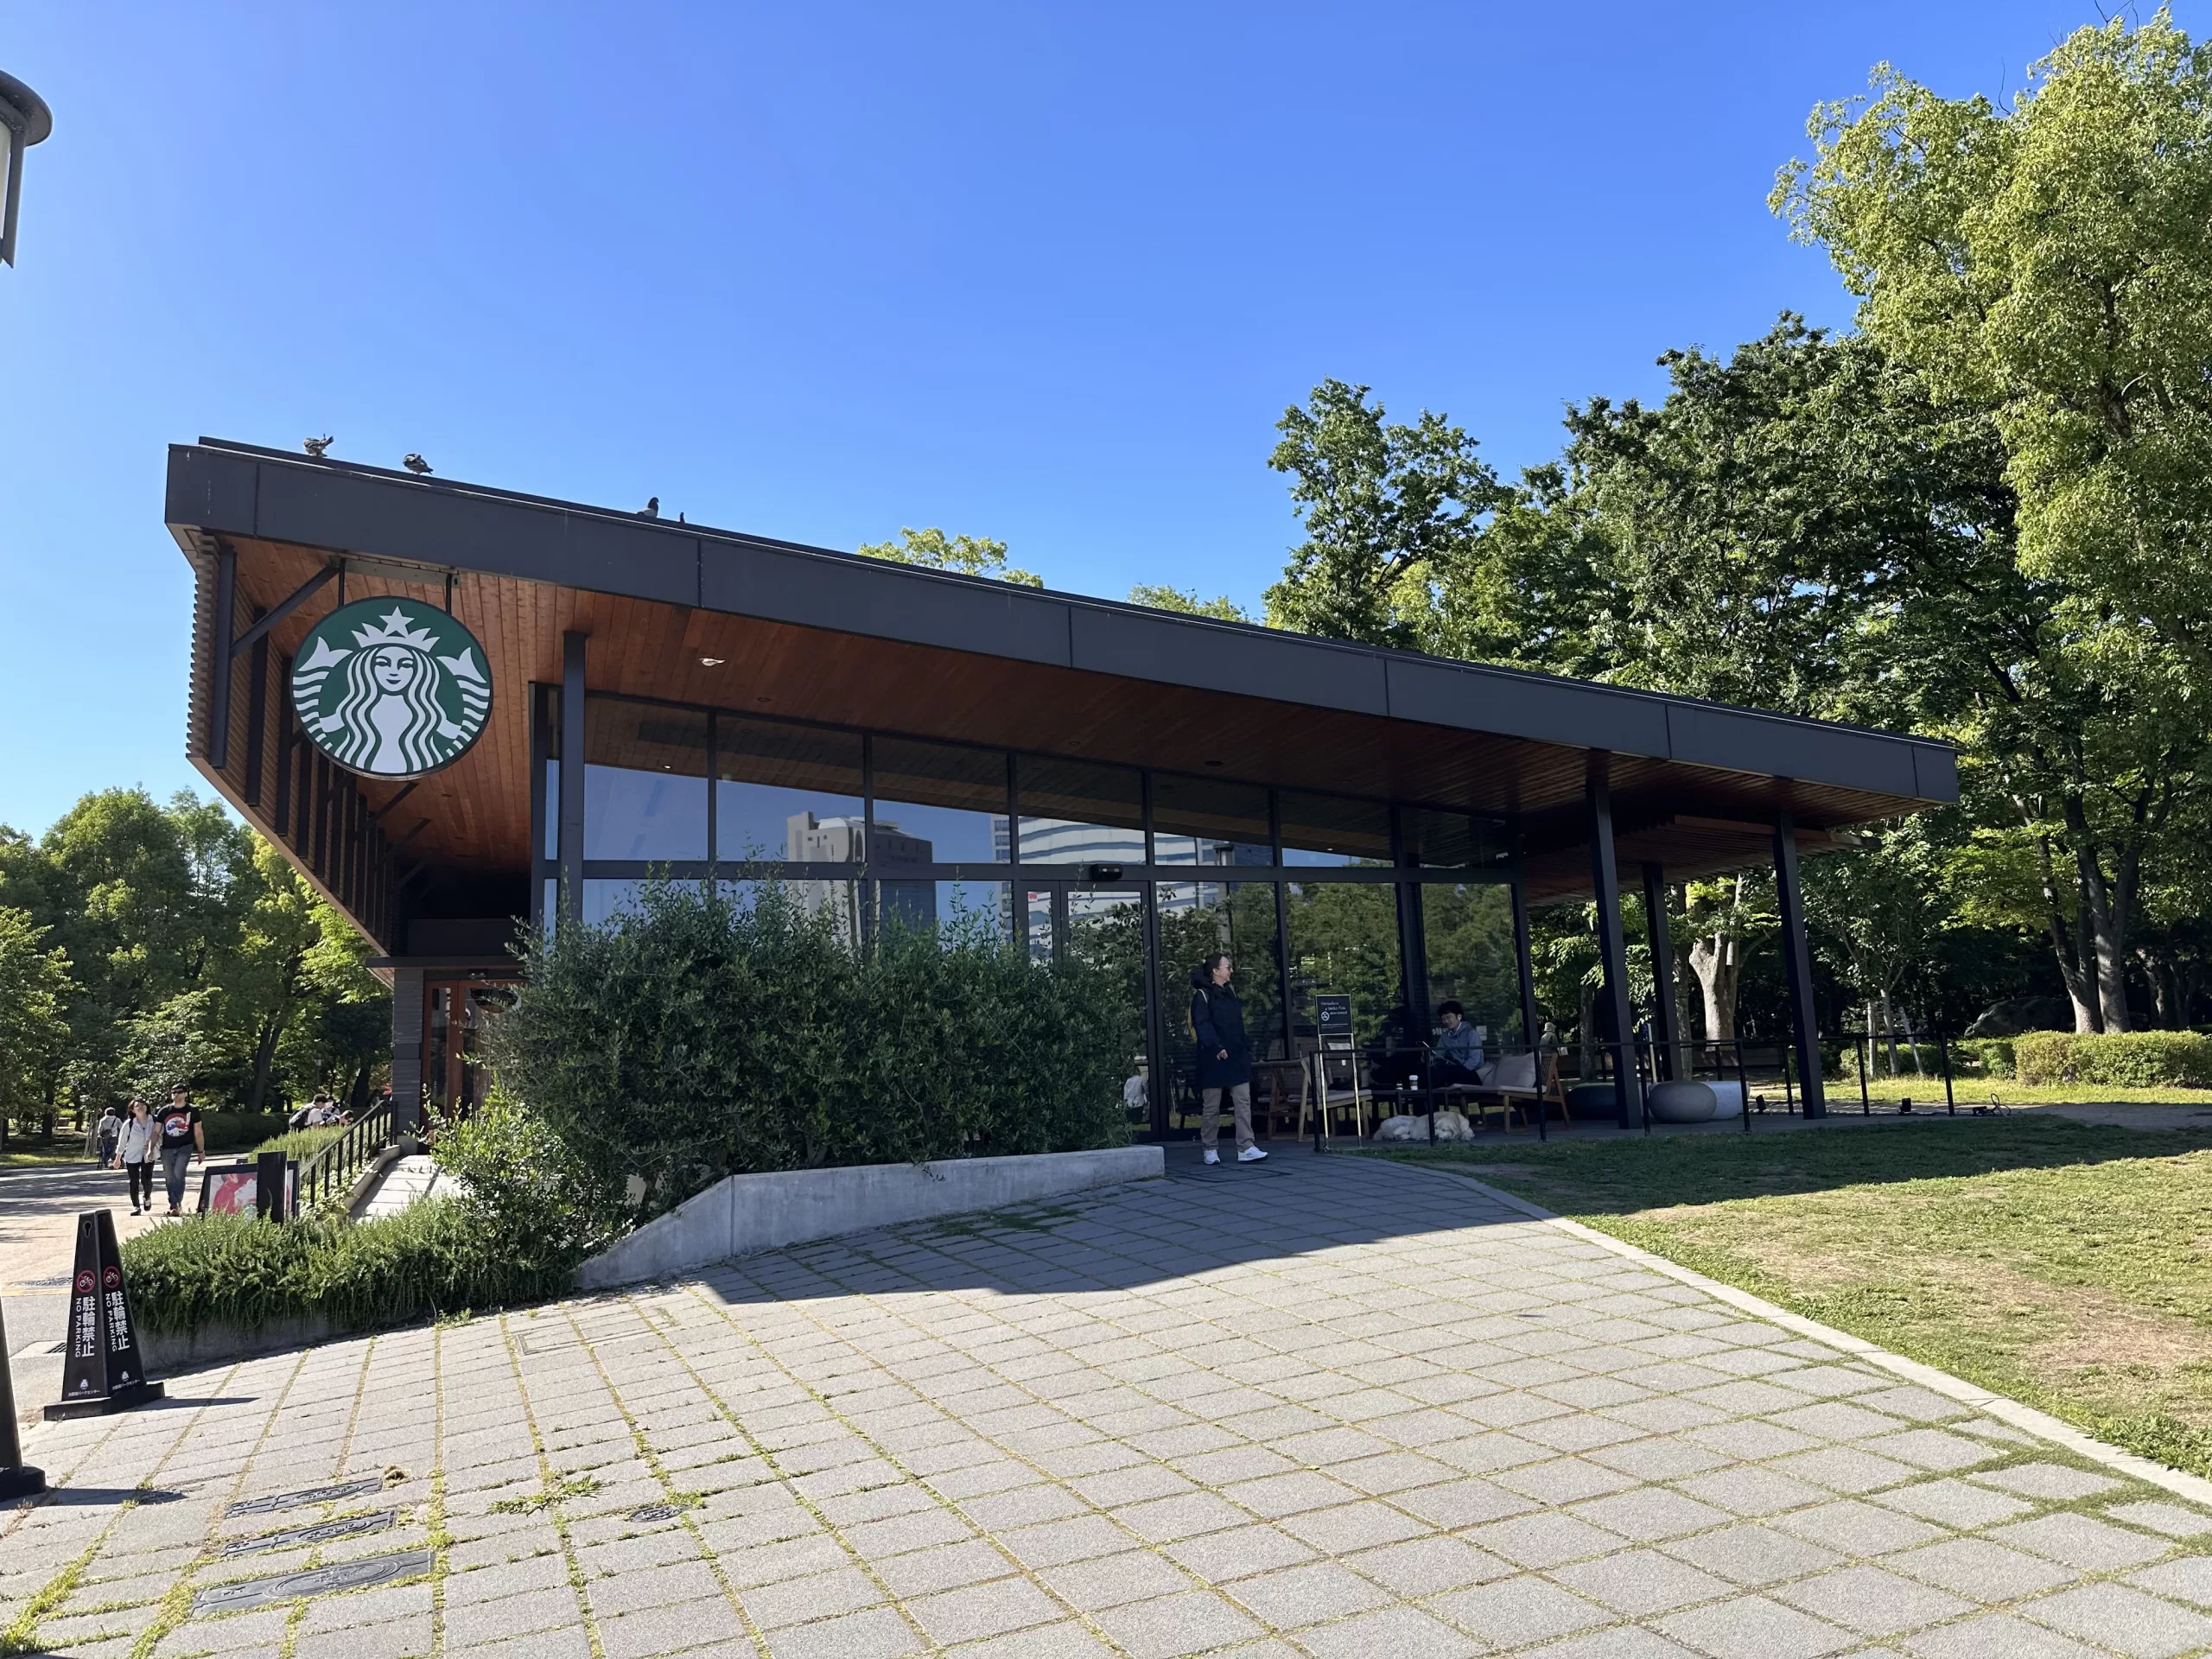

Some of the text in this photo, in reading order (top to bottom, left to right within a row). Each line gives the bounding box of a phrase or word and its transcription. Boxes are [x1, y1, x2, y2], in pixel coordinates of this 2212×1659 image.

[76, 1298, 81, 1312] NO
[82, 1296, 95, 1357] 駐輪禁止
[105, 1294, 117, 1351] NO PARKING
[111, 1291, 130, 1351] 駐輪禁止
